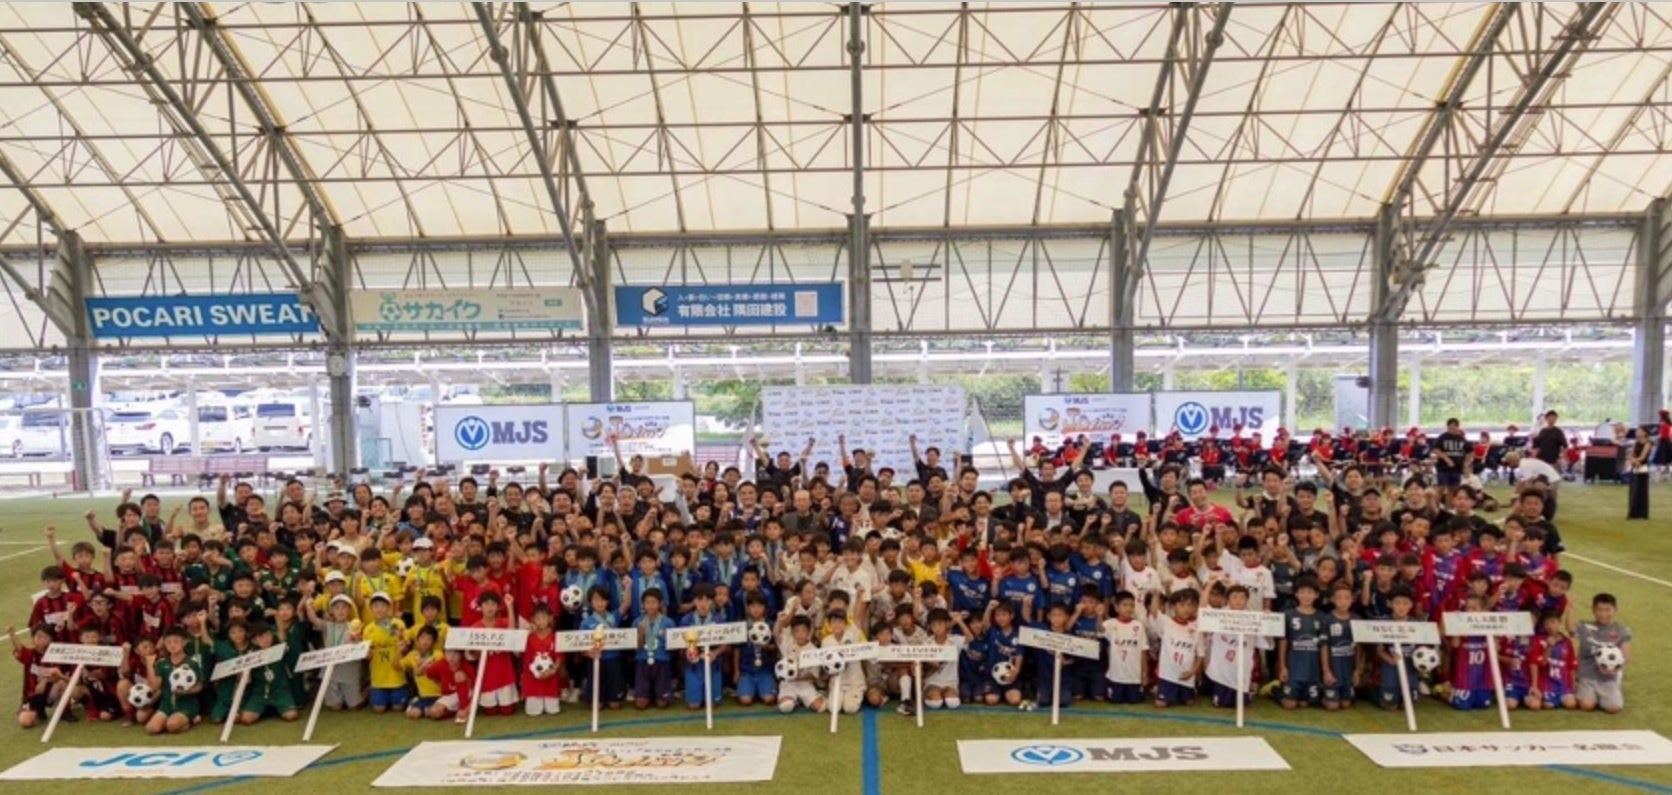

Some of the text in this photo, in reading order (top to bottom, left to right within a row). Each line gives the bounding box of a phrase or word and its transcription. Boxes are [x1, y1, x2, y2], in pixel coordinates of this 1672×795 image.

[92, 303, 312, 328] POCARI SWEAT
[403, 299, 481, 320] サカイク
[677, 303, 731, 318] 有限会社
[1211, 406, 1264, 429] MJS
[492, 420, 548, 444] MJS
[1291, 617, 1301, 630] 5
[1468, 651, 1485, 665] 10
[78, 752, 207, 767] JCI
[1086, 746, 1210, 761] MJS
